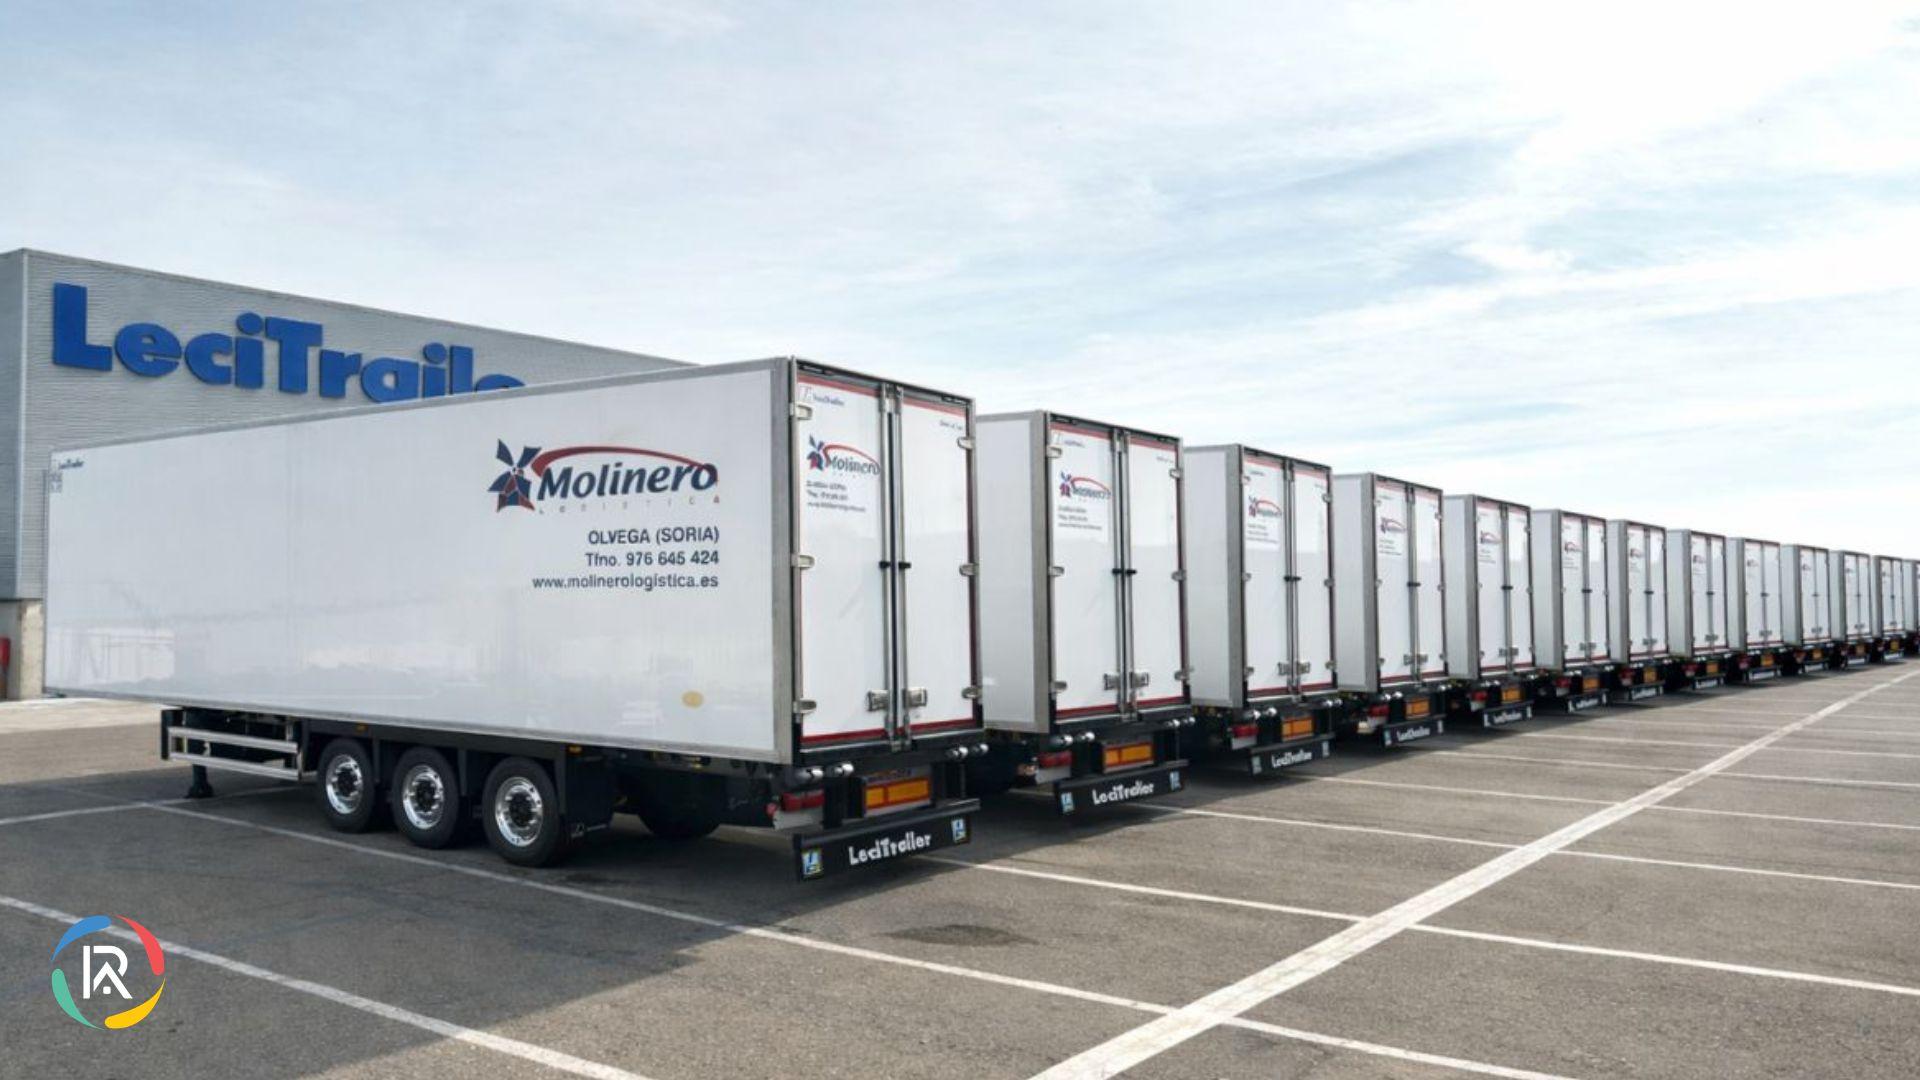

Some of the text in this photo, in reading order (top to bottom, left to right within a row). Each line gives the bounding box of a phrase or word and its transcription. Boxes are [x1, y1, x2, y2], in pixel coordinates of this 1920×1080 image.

[537, 461, 718, 501] Molinero
[588, 526, 720, 545] OLVEGA (SORIA)
[585, 550, 719, 567] Tfno. 976 645 424
[849, 831, 932, 866] LeciTrailer
